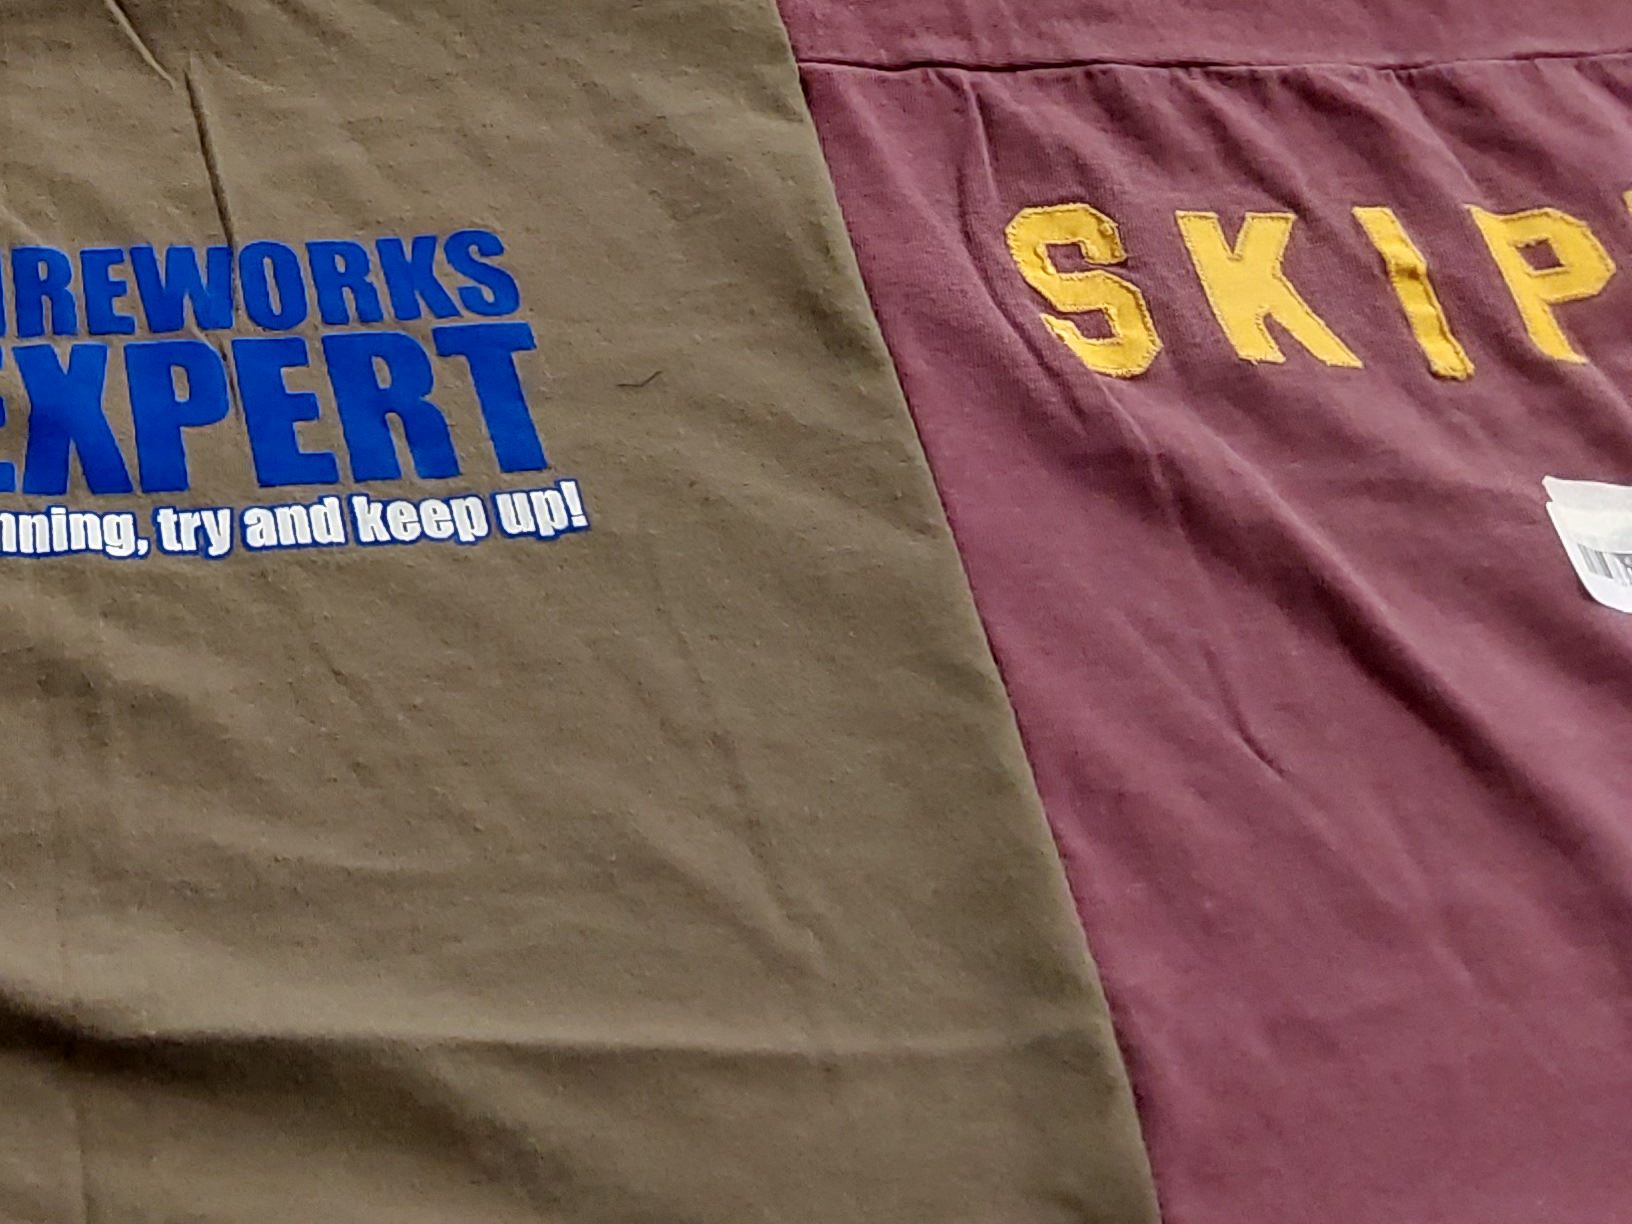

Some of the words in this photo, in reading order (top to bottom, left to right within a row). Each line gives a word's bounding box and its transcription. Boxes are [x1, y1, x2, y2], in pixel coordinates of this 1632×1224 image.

[1005, 190, 1632, 380] SKIP
[155, 506, 234, 558] try
[242, 494, 347, 548] and
[351, 492, 489, 544] keep
[493, 480, 590, 539] up!
